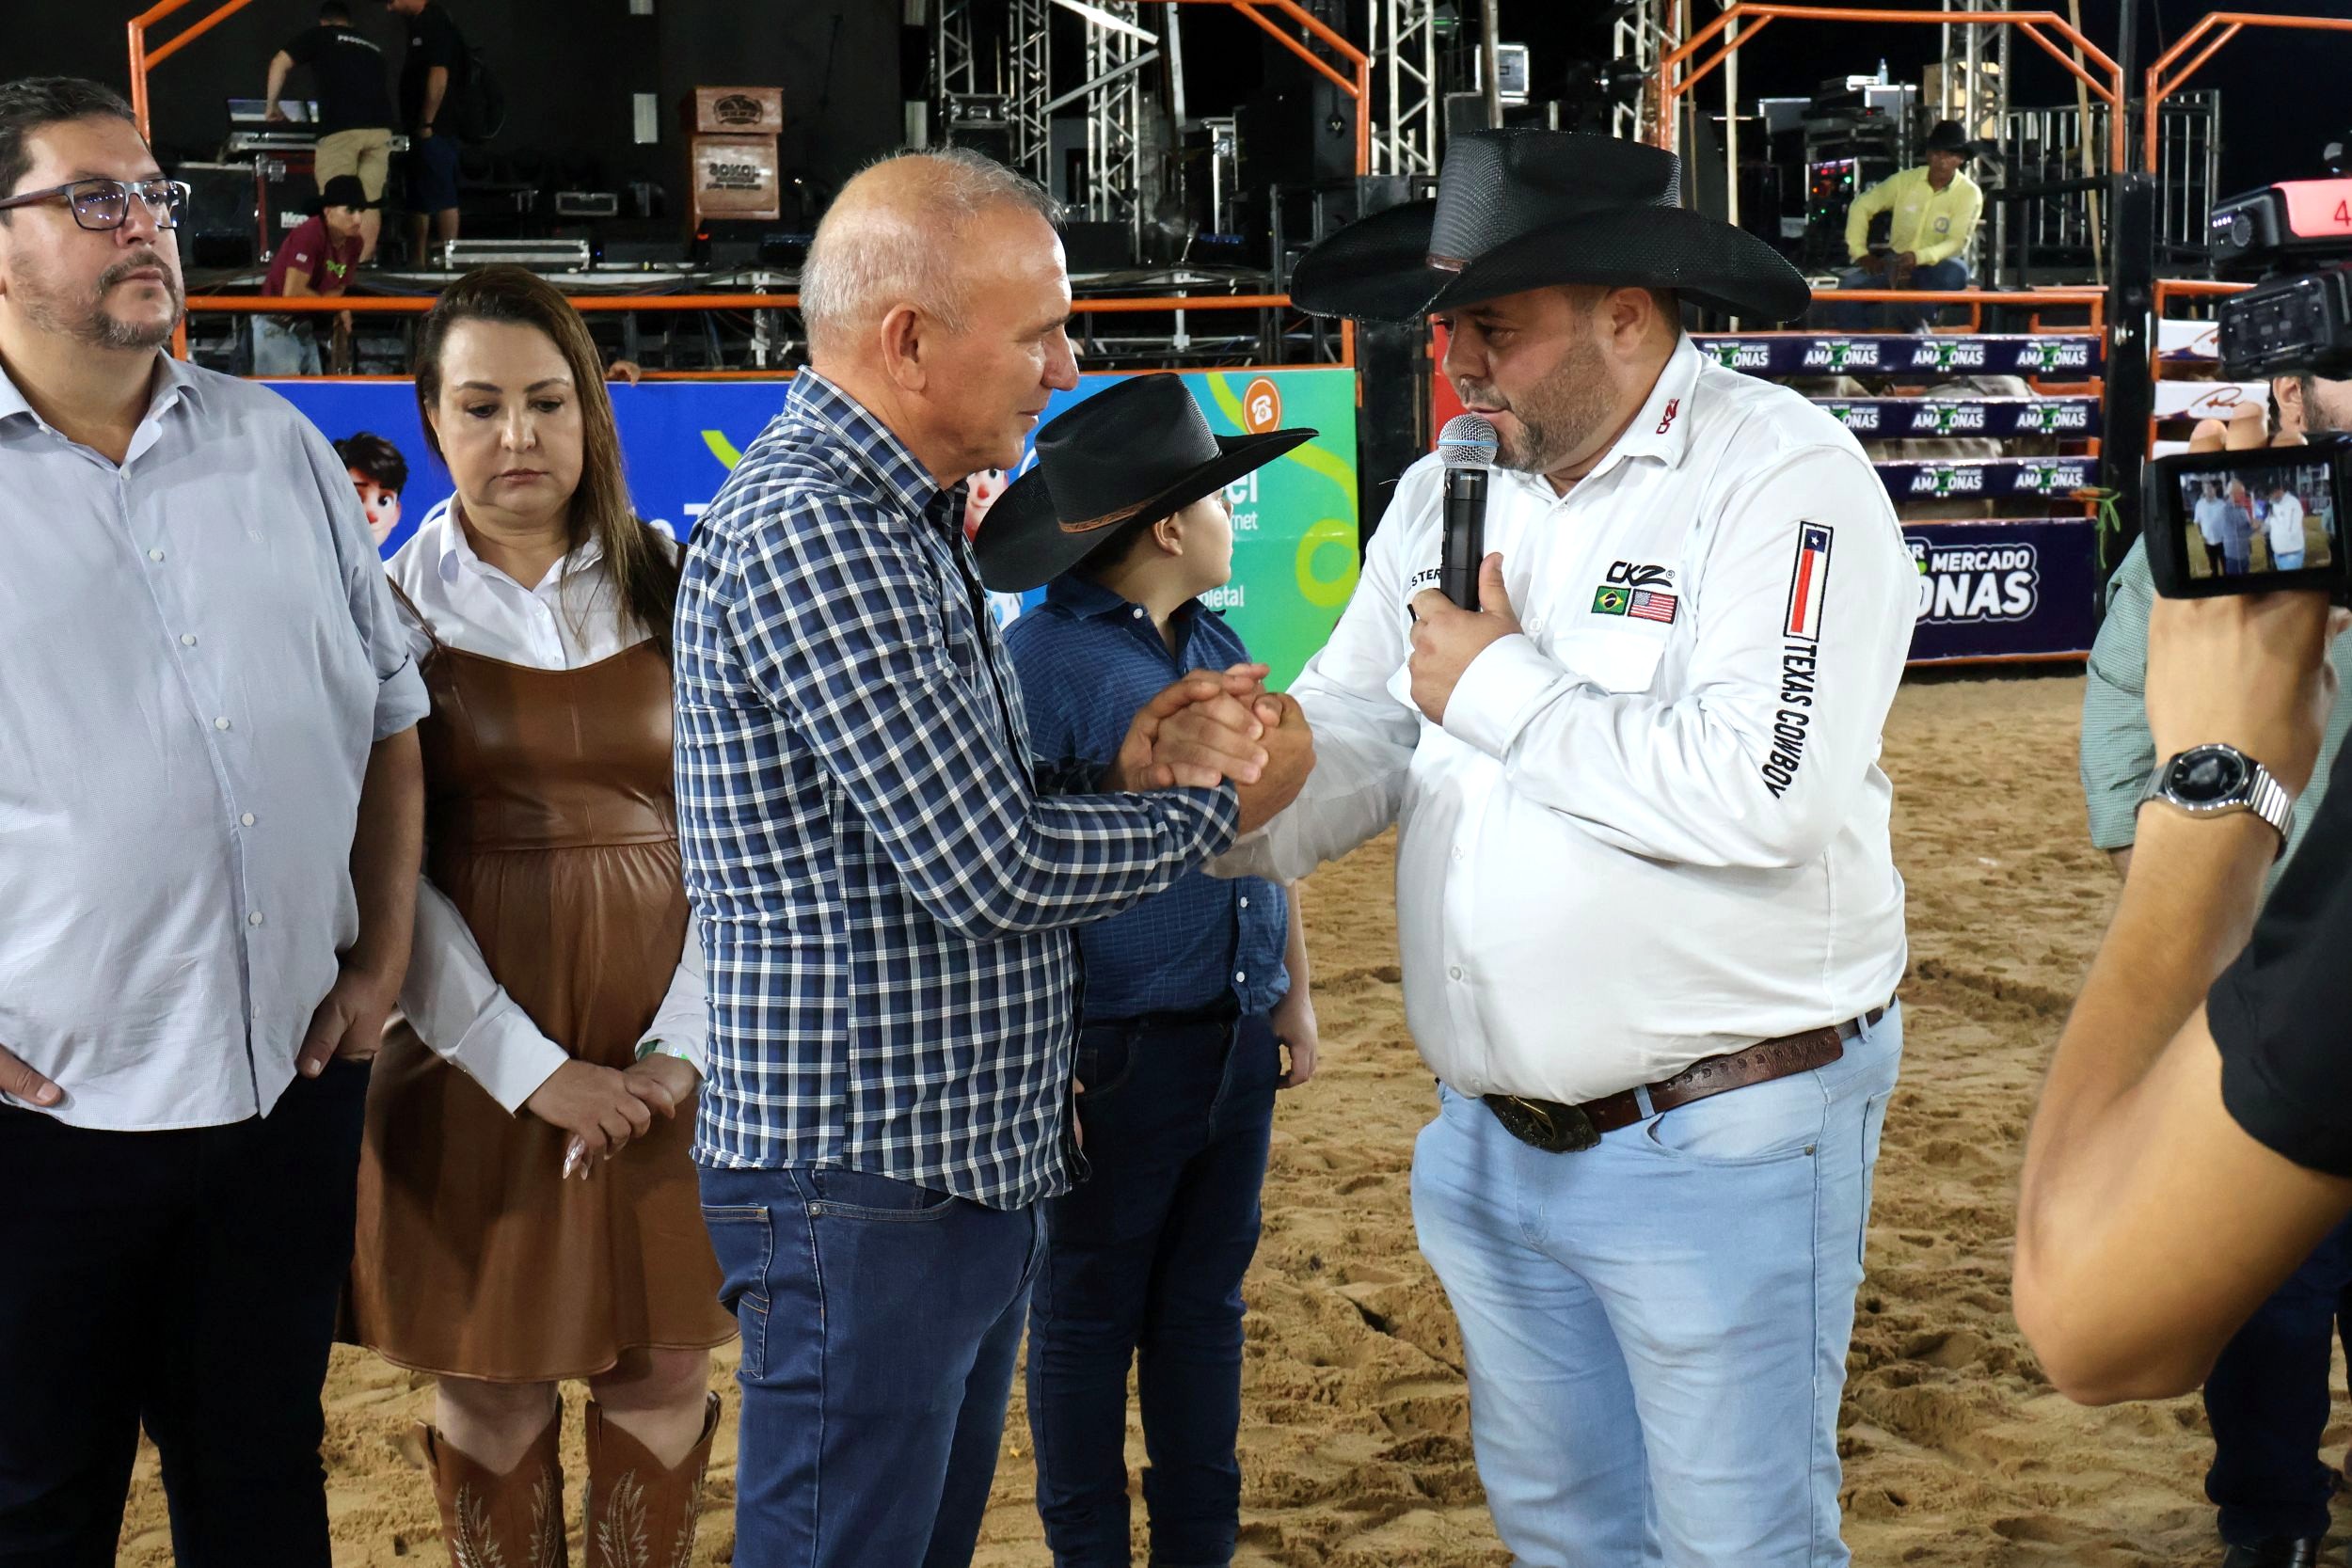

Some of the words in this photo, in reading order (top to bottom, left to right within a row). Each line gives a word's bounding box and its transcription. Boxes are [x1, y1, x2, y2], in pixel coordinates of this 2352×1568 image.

[2333, 199, 2352, 227] 4
[1804, 349, 1878, 365] AMAZONAS
[1913, 350, 1984, 365] AMAZONAS
[2016, 350, 2088, 365] AMAZONAS
[1913, 413, 1984, 428] AMAZONAS
[2016, 413, 2087, 428] AMAZONAS
[1225, 469, 1258, 504] el
[1912, 476, 1982, 490] AMAZONAS
[2015, 473, 2083, 487] AMAZONAS
[1931, 550, 2030, 572] MERCADO
[1411, 568, 1441, 587] STER
[1918, 570, 2033, 617] ONAS
[1781, 644, 1818, 707] TEXAS
[1761, 708, 1810, 800] COWBOY
